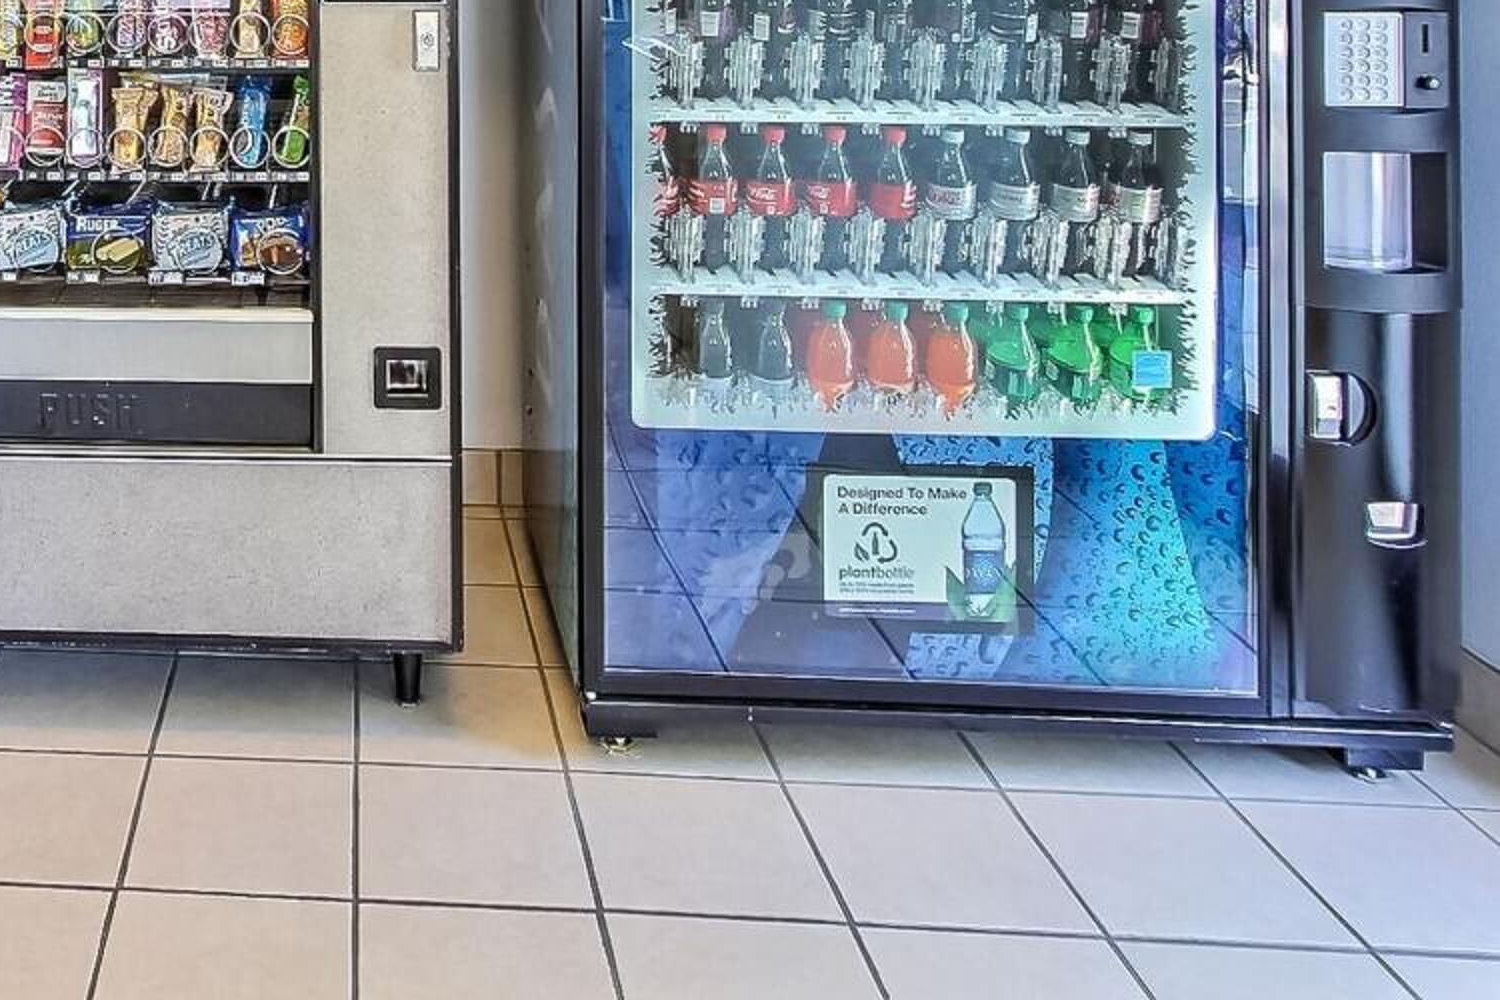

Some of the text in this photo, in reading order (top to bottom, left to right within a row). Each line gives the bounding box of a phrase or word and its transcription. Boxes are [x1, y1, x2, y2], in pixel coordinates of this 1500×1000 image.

[40, 391, 143, 434] PUSH
[837, 485, 967, 501] Designed To Make
[838, 503, 928, 516] A Difference
[839, 564, 915, 580] plantbottle
